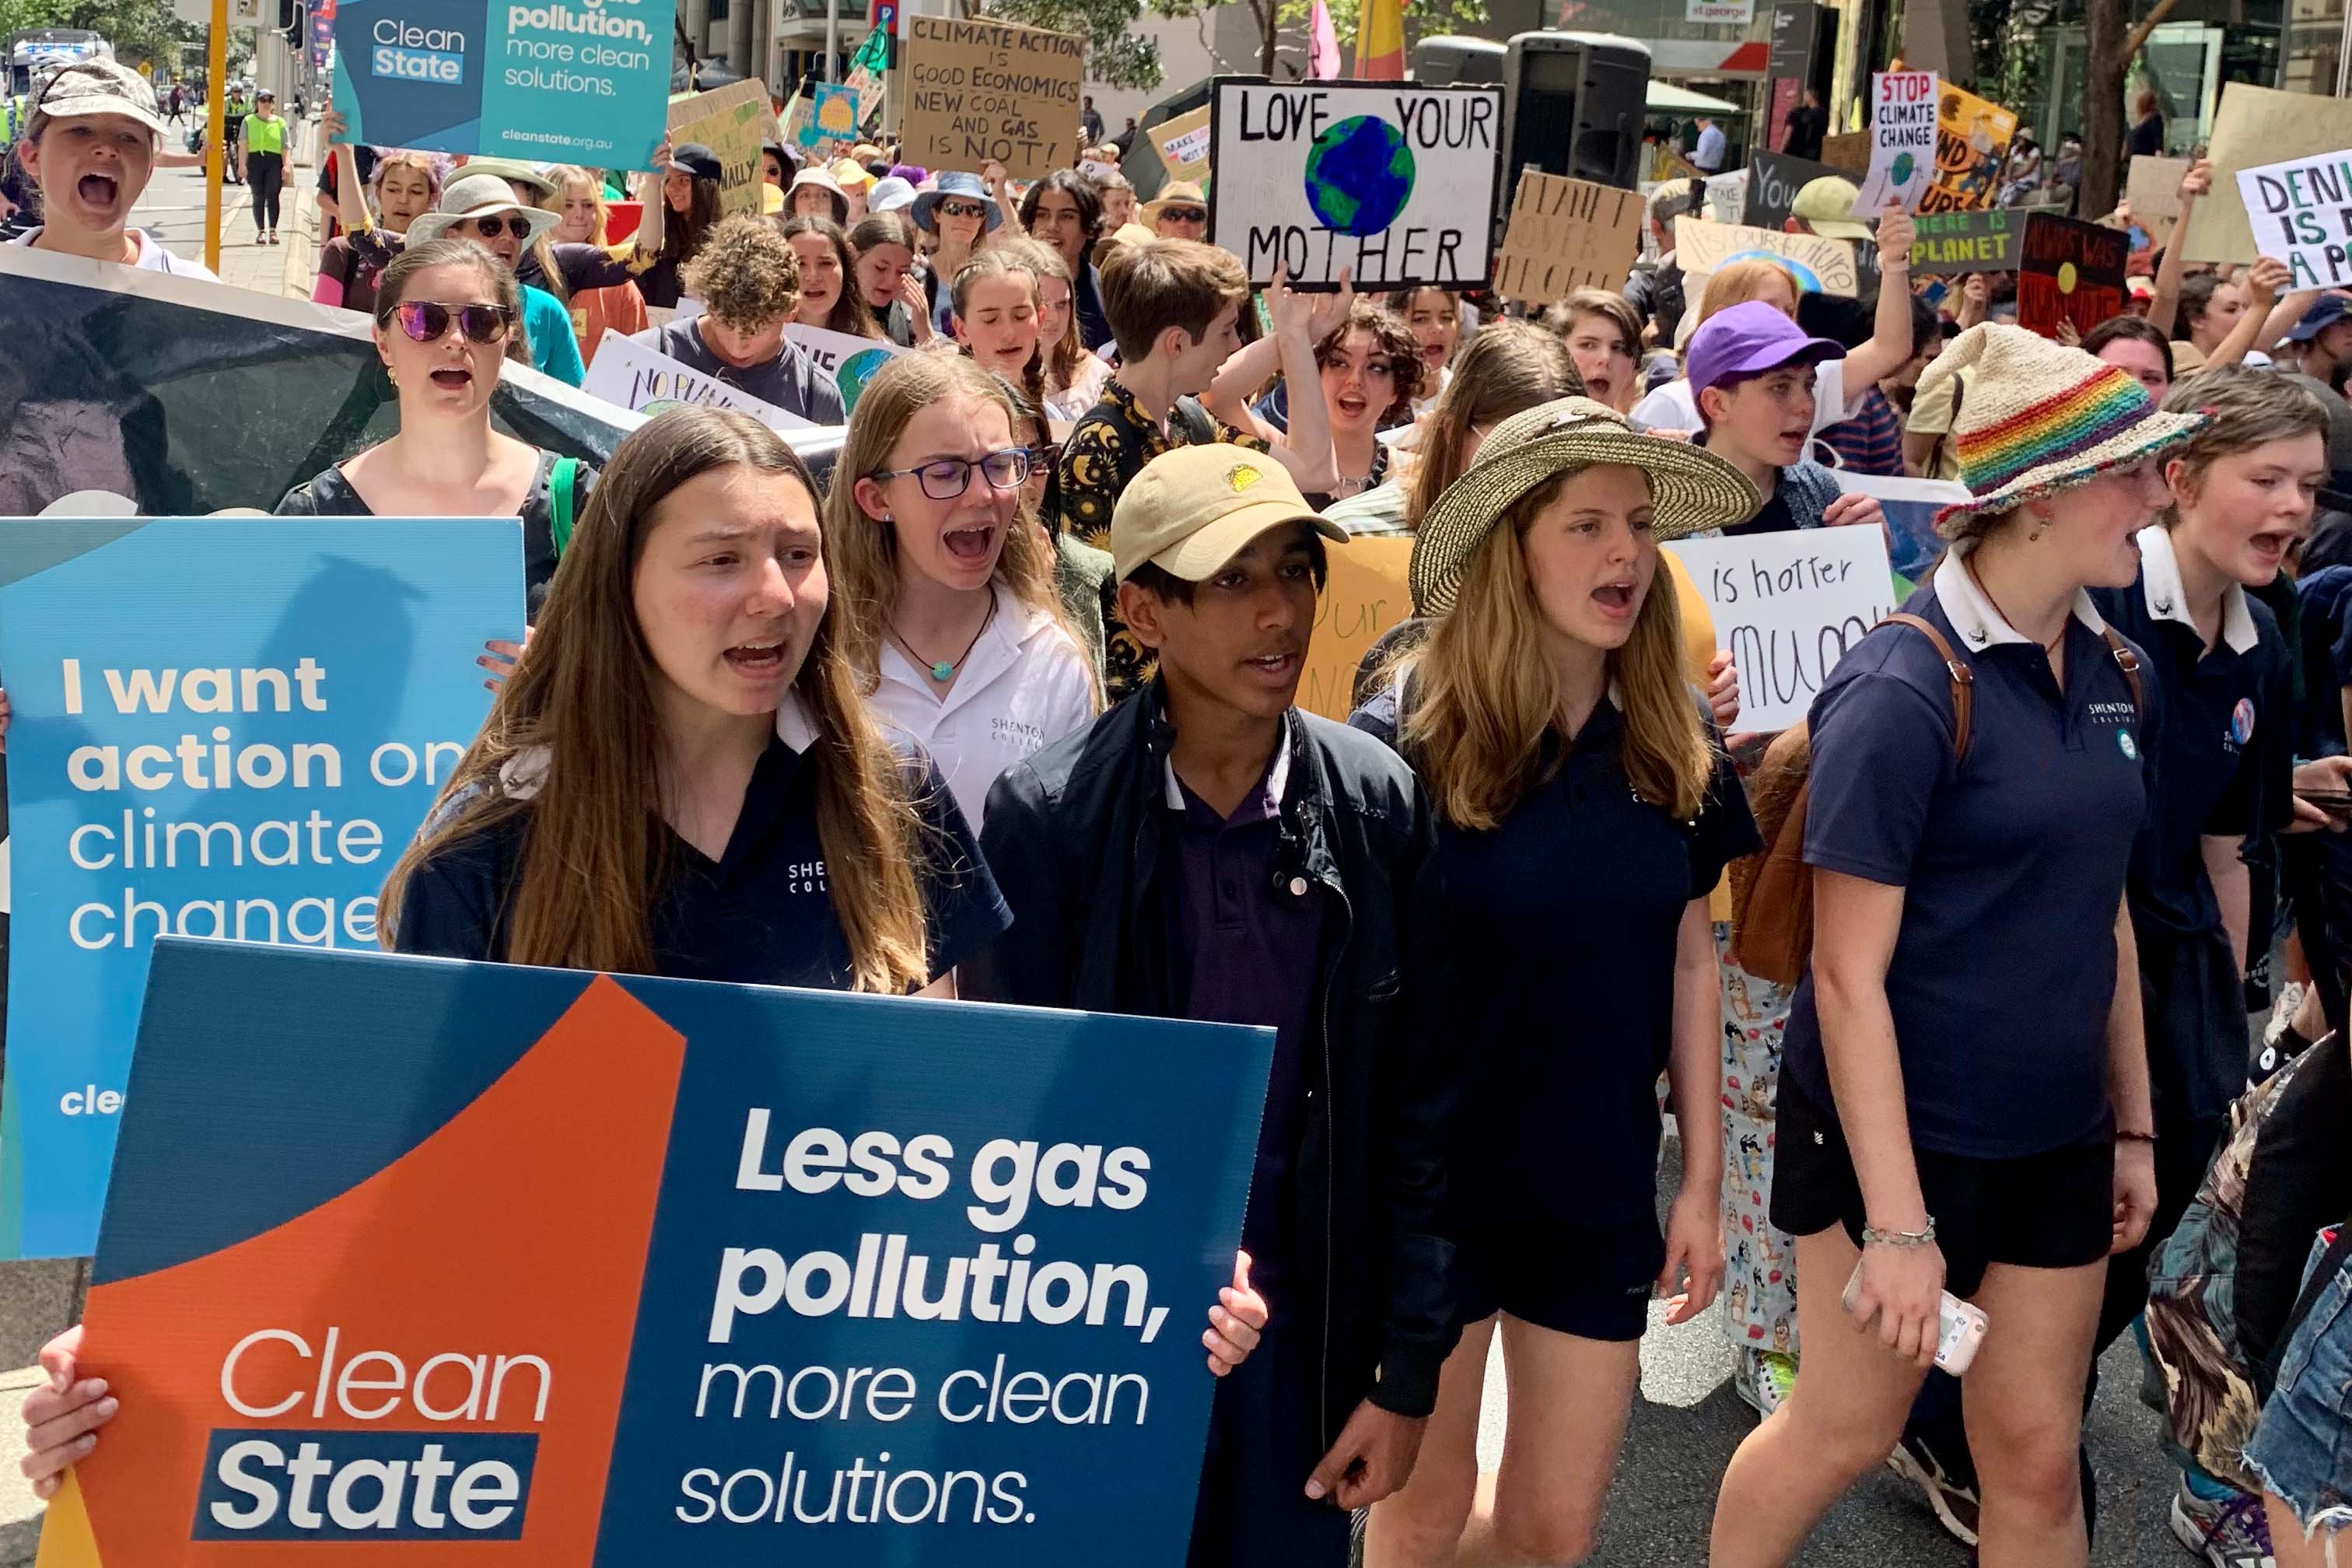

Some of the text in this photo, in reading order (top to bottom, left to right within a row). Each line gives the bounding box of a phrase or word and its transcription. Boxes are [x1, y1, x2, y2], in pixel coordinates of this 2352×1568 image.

[373, 19, 464, 52] Clean
[508, 5, 653, 45] pollution,
[914, 20, 1014, 49] CLIMATE
[1019, 31, 1083, 58] ACTION
[376, 49, 460, 81] State
[507, 39, 649, 70] more clean
[989, 51, 1008, 67] IS
[504, 67, 617, 96] solutions.
[914, 63, 965, 85] GOOD
[972, 67, 1080, 103] ECONOMICS
[1881, 75, 1930, 102] STOP
[914, 92, 1022, 117] NEW COAL
[1241, 90, 1493, 149] LOVE YOUR
[1878, 104, 1934, 124] CLIMATE
[502, 128, 613, 150] cleanstate.org.au
[929, 135, 952, 155] IS
[951, 116, 1038, 138] AND GAS
[1880, 127, 1930, 147] CHANGE
[1989, 210, 2006, 230] IS
[2279, 211, 2327, 246] IS
[1248, 226, 1462, 282] MOTHER
[1911, 231, 2012, 266] PLANET
[2289, 250, 2320, 289] A
[629, 368, 669, 410] NO
[1713, 561, 1738, 604] is
[62, 657, 327, 714] I want
[2088, 702, 2134, 714] SHENTON
[992, 718, 1045, 740] SHENTON
[67, 726, 465, 791] action on
[70, 807, 383, 870] climate
[70, 887, 379, 950] change
[60, 1084, 126, 1115] cle
[735, 1108, 1151, 1233] Less gas
[708, 1232, 1170, 1343] pollution,
[220, 1326, 553, 1423] Clean
[695, 1354, 1149, 1424] more clean
[209, 1440, 520, 1531] State
[675, 1451, 1036, 1524] solutions.
